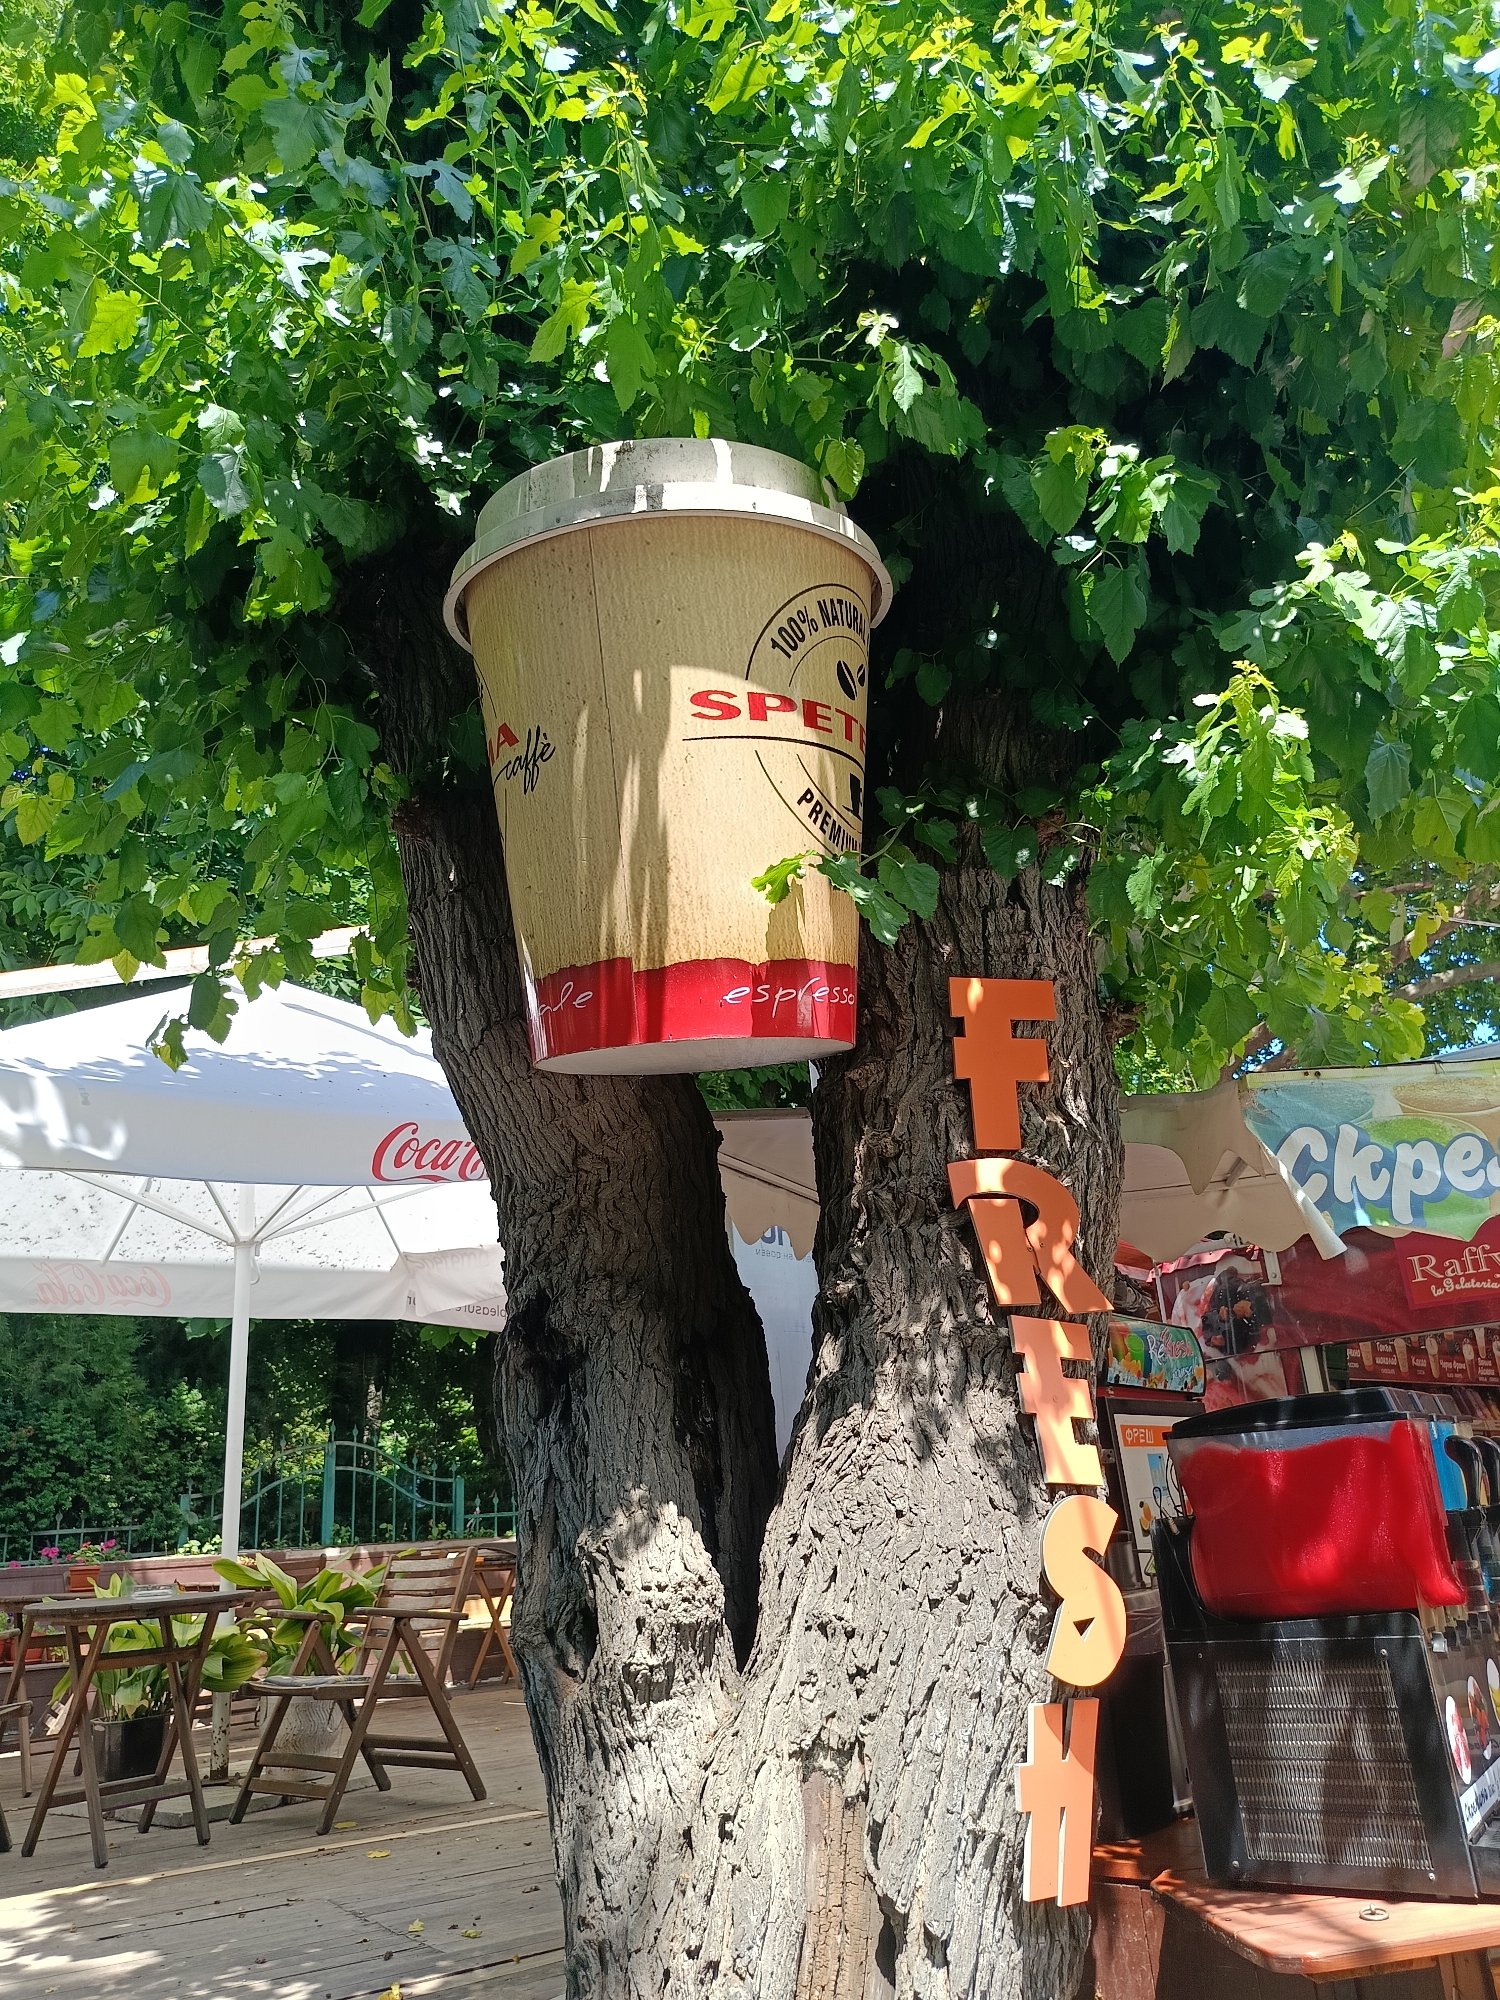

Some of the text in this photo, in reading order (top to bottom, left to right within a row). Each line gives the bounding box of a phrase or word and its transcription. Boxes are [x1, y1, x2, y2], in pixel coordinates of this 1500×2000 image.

[771, 605, 819, 660] 100%
[493, 724, 556, 796] caffè
[536, 980, 594, 1018] ale
[721, 976, 855, 1019] espresso
[371, 1121, 489, 1183] Coca-C
[1443, 1276, 1500, 1293] Gelateria
[946, 976, 1128, 1908] FRESH
[1125, 1427, 1155, 1444] ФРЕШ
